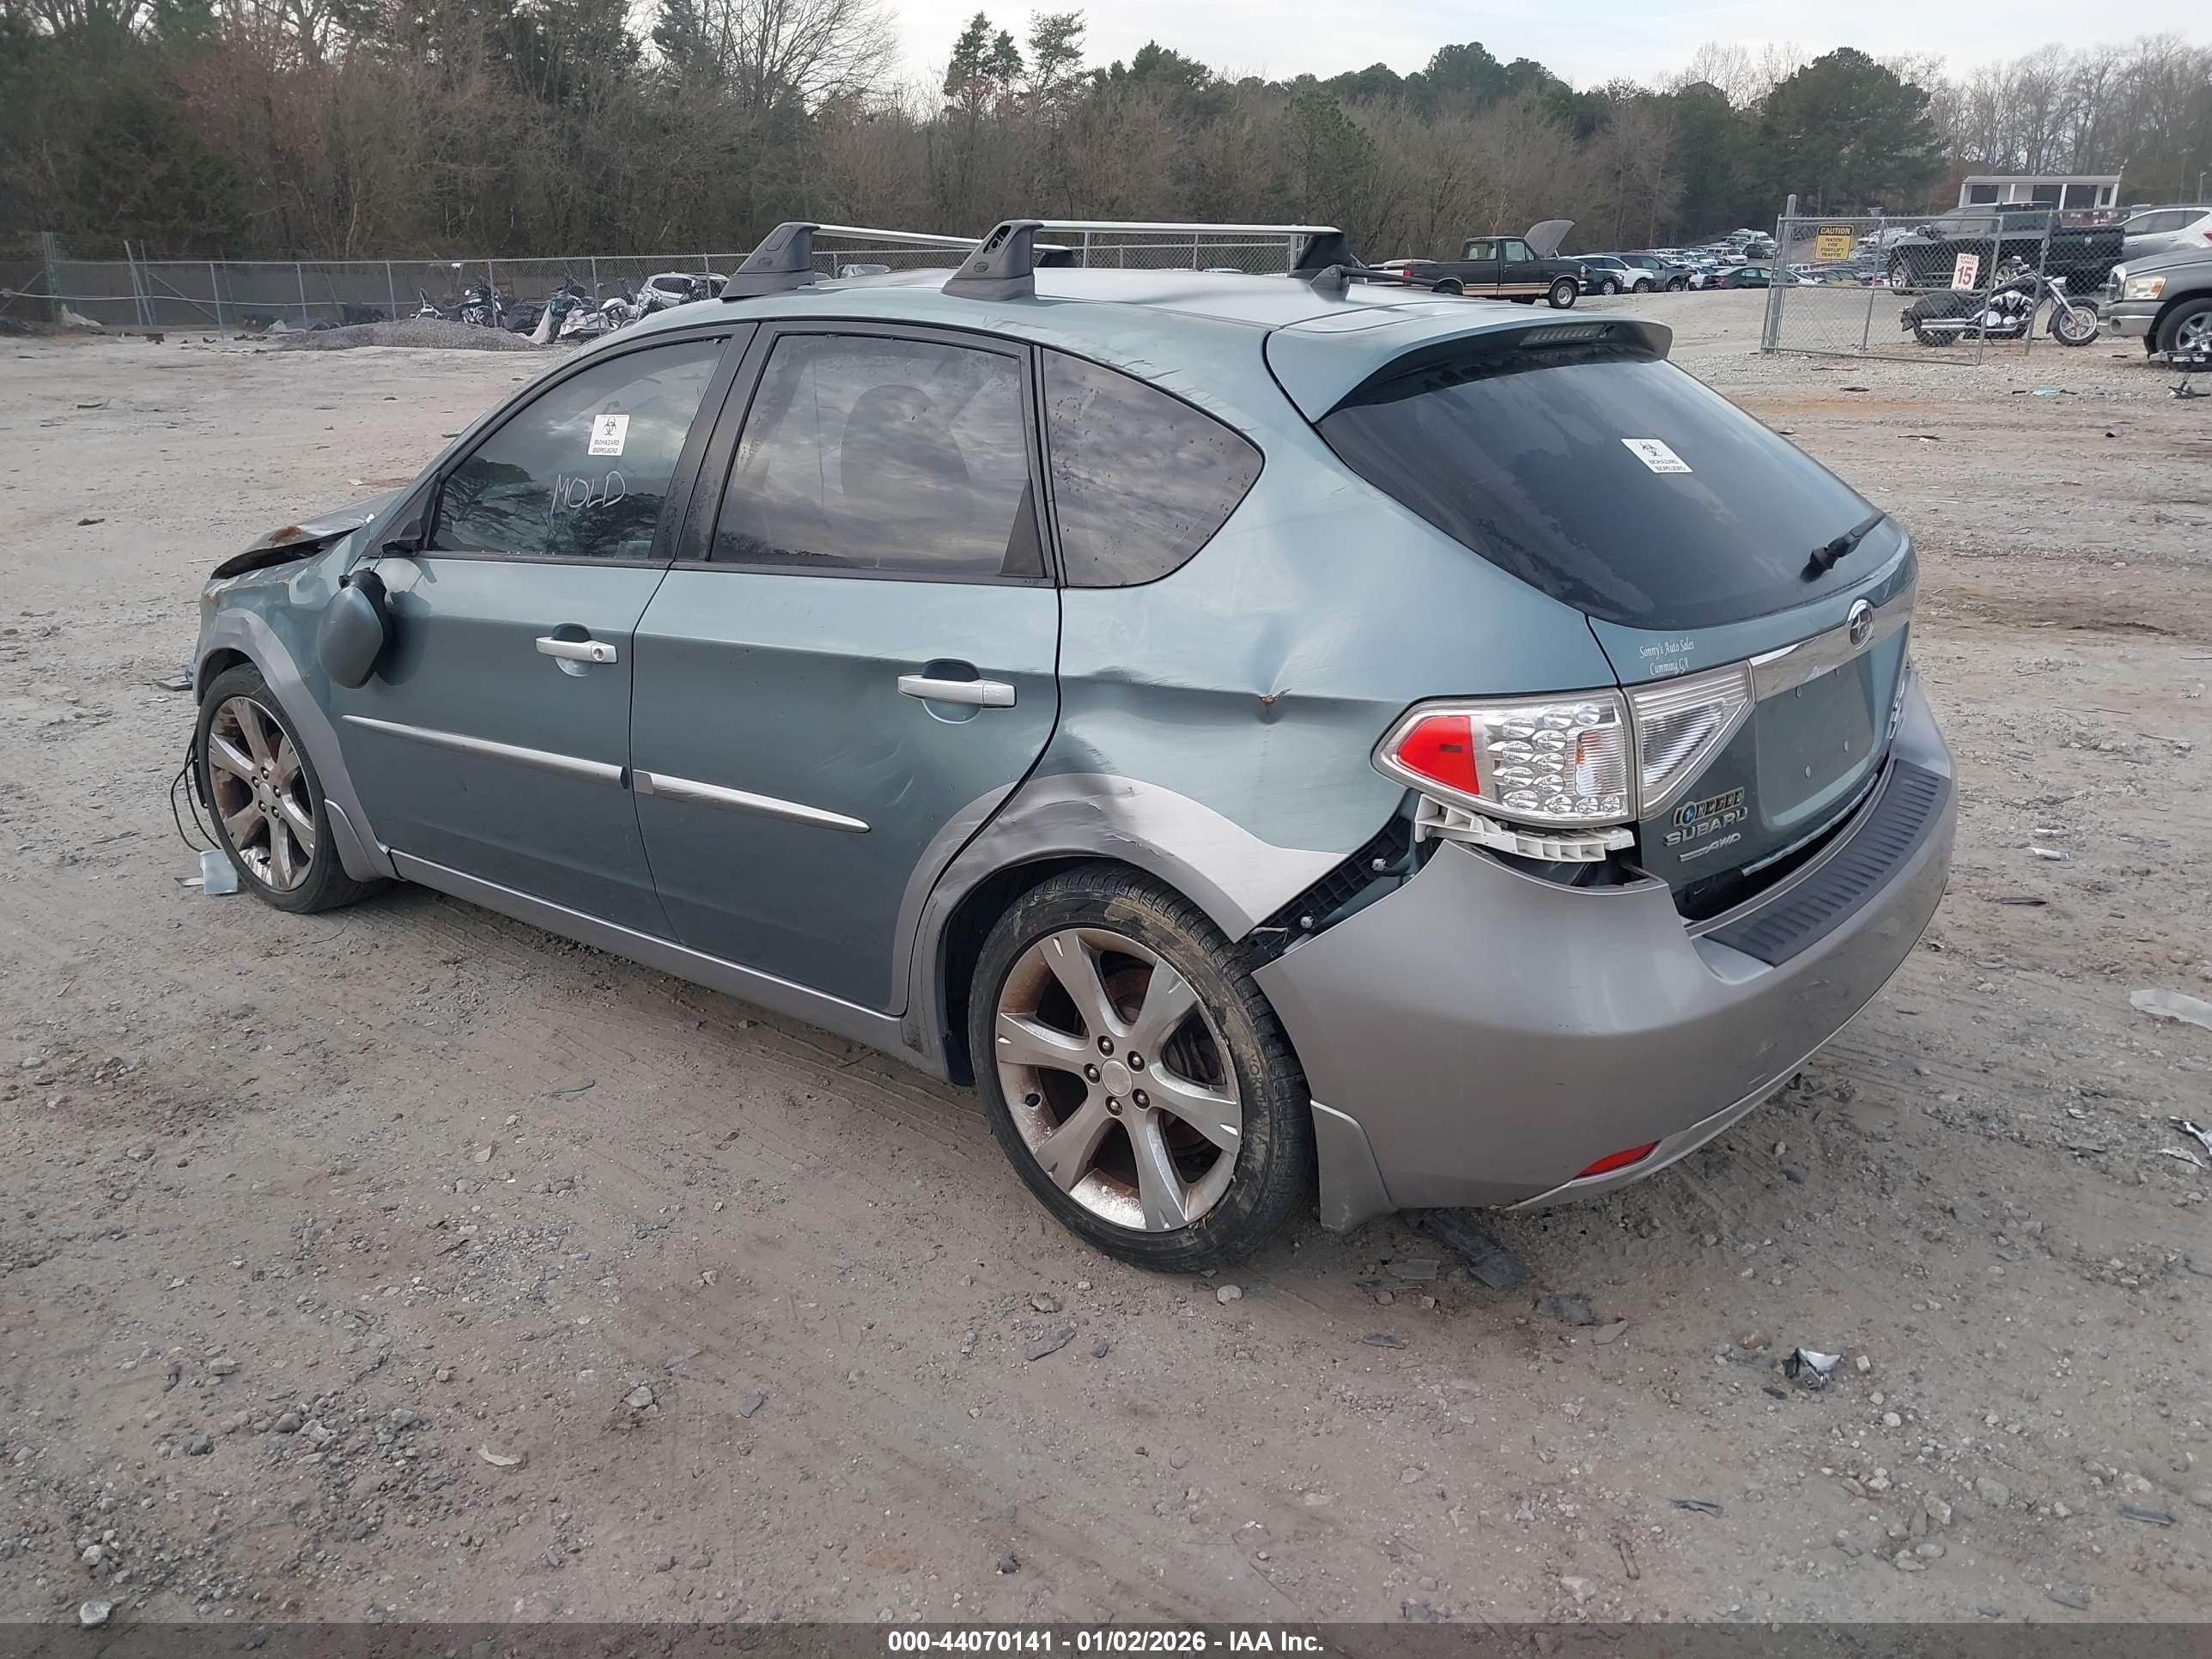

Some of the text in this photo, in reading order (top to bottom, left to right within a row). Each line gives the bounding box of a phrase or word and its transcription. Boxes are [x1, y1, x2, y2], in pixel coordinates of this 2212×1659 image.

[1958, 266, 1973, 285] 15
[550, 471, 625, 516] MOLD
[1639, 637, 1695, 659] Sonny's Auto Sales
[1664, 806, 1748, 847] SUBARU
[1705, 832, 1741, 854] AWD
